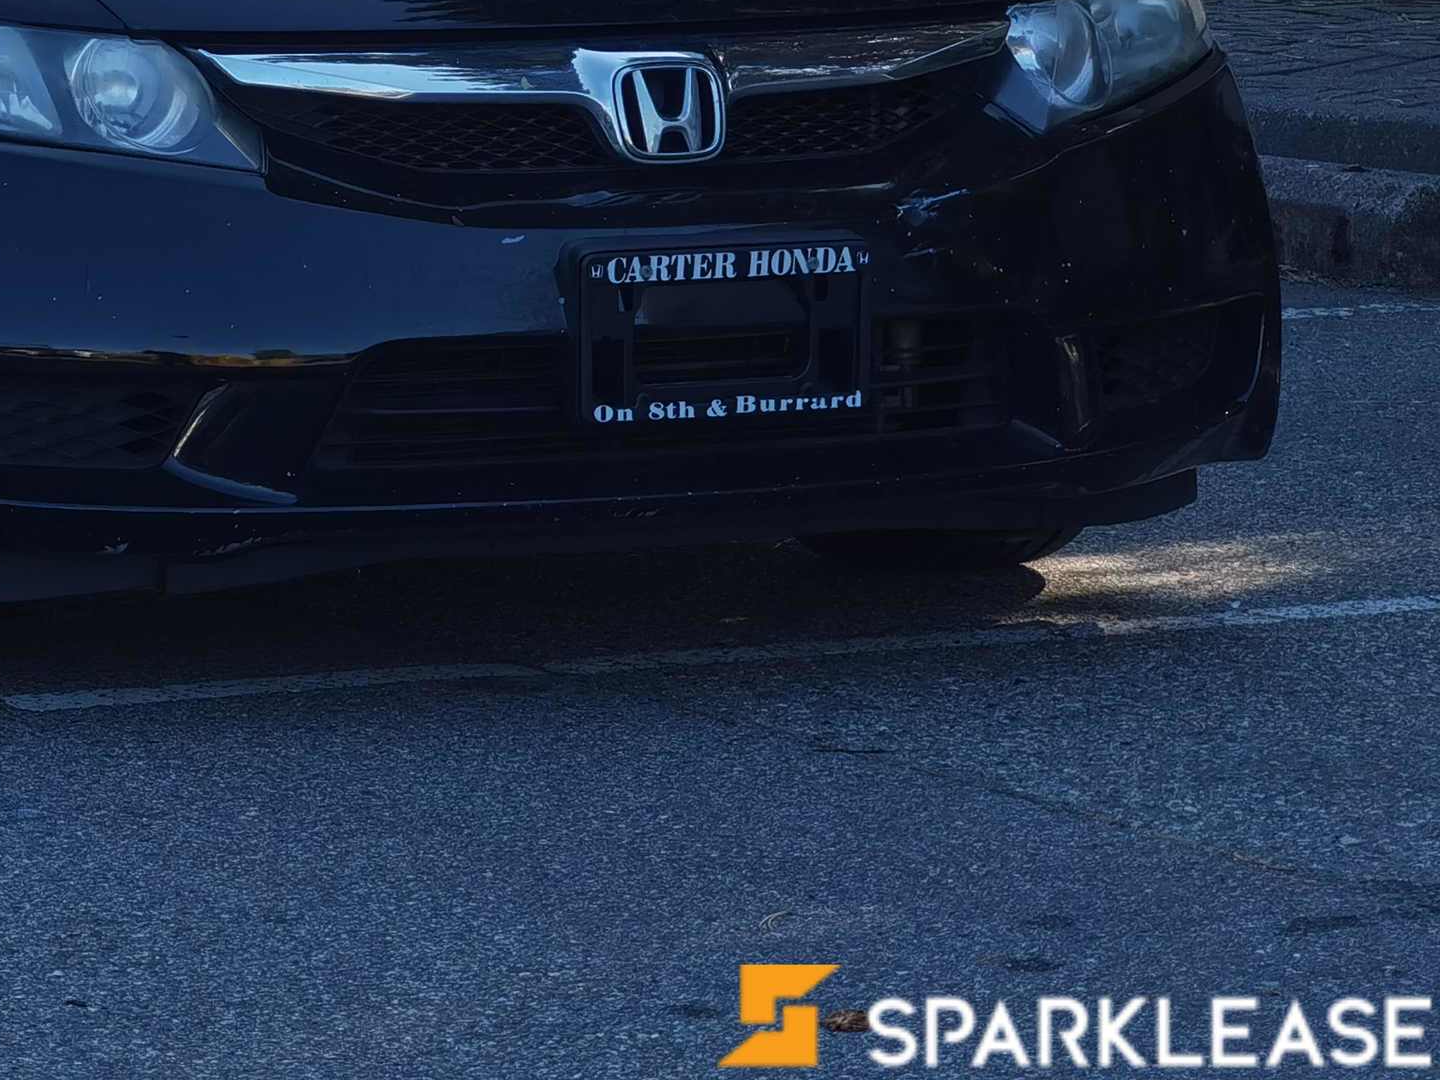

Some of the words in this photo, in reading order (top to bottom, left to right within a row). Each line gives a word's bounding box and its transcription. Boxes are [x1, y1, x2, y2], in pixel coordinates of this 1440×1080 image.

[608, 256, 736, 284] CARTER
[747, 246, 856, 277] HONDA
[593, 404, 634, 422] On
[648, 401, 696, 420] 8th
[706, 398, 728, 418] &
[735, 390, 862, 414] Burrard
